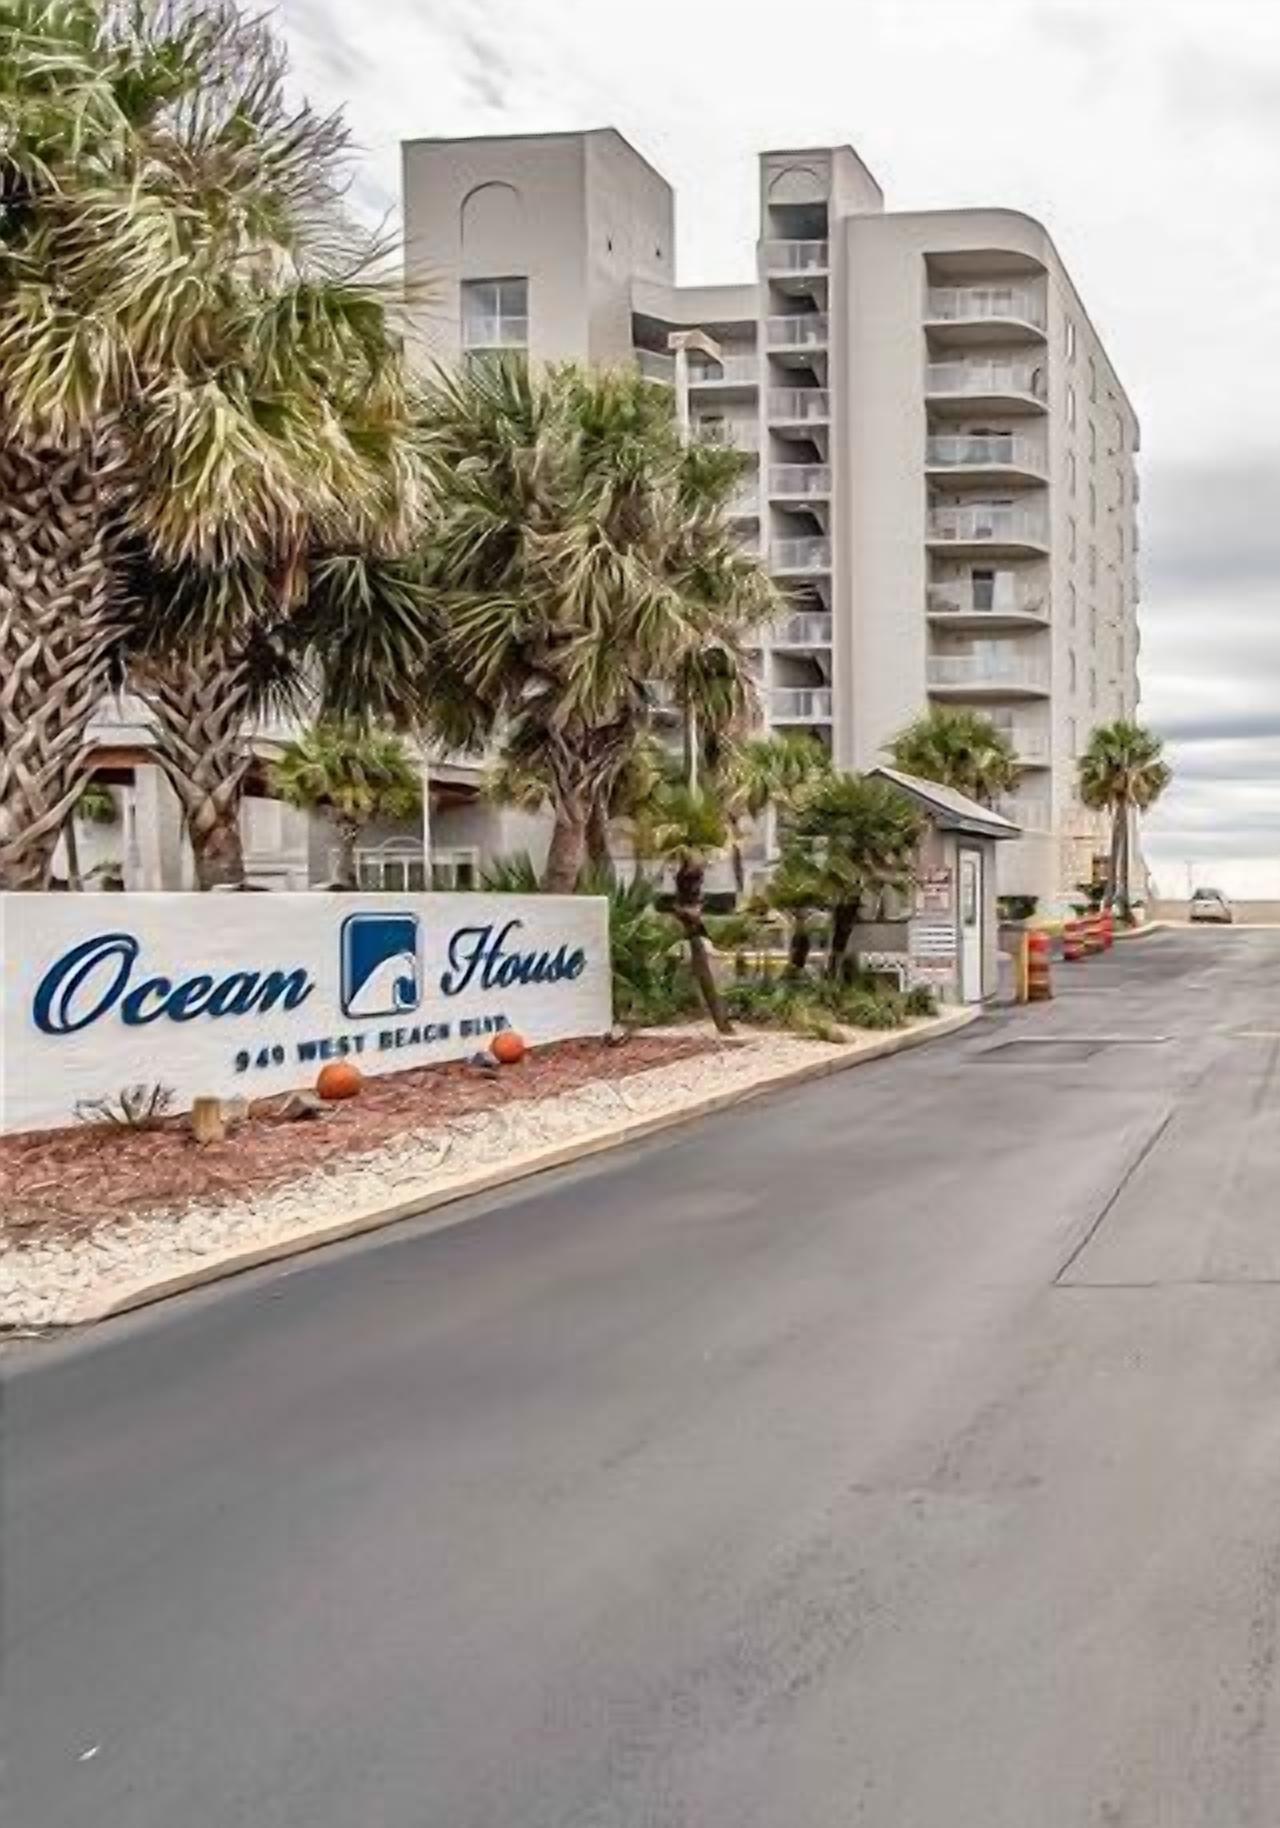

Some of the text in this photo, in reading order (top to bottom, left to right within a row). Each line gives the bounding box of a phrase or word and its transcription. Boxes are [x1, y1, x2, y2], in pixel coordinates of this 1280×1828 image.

[33, 919, 588, 1034] Ocean House
[235, 1045, 285, 1072] 949
[297, 1034, 365, 1061] WEST
